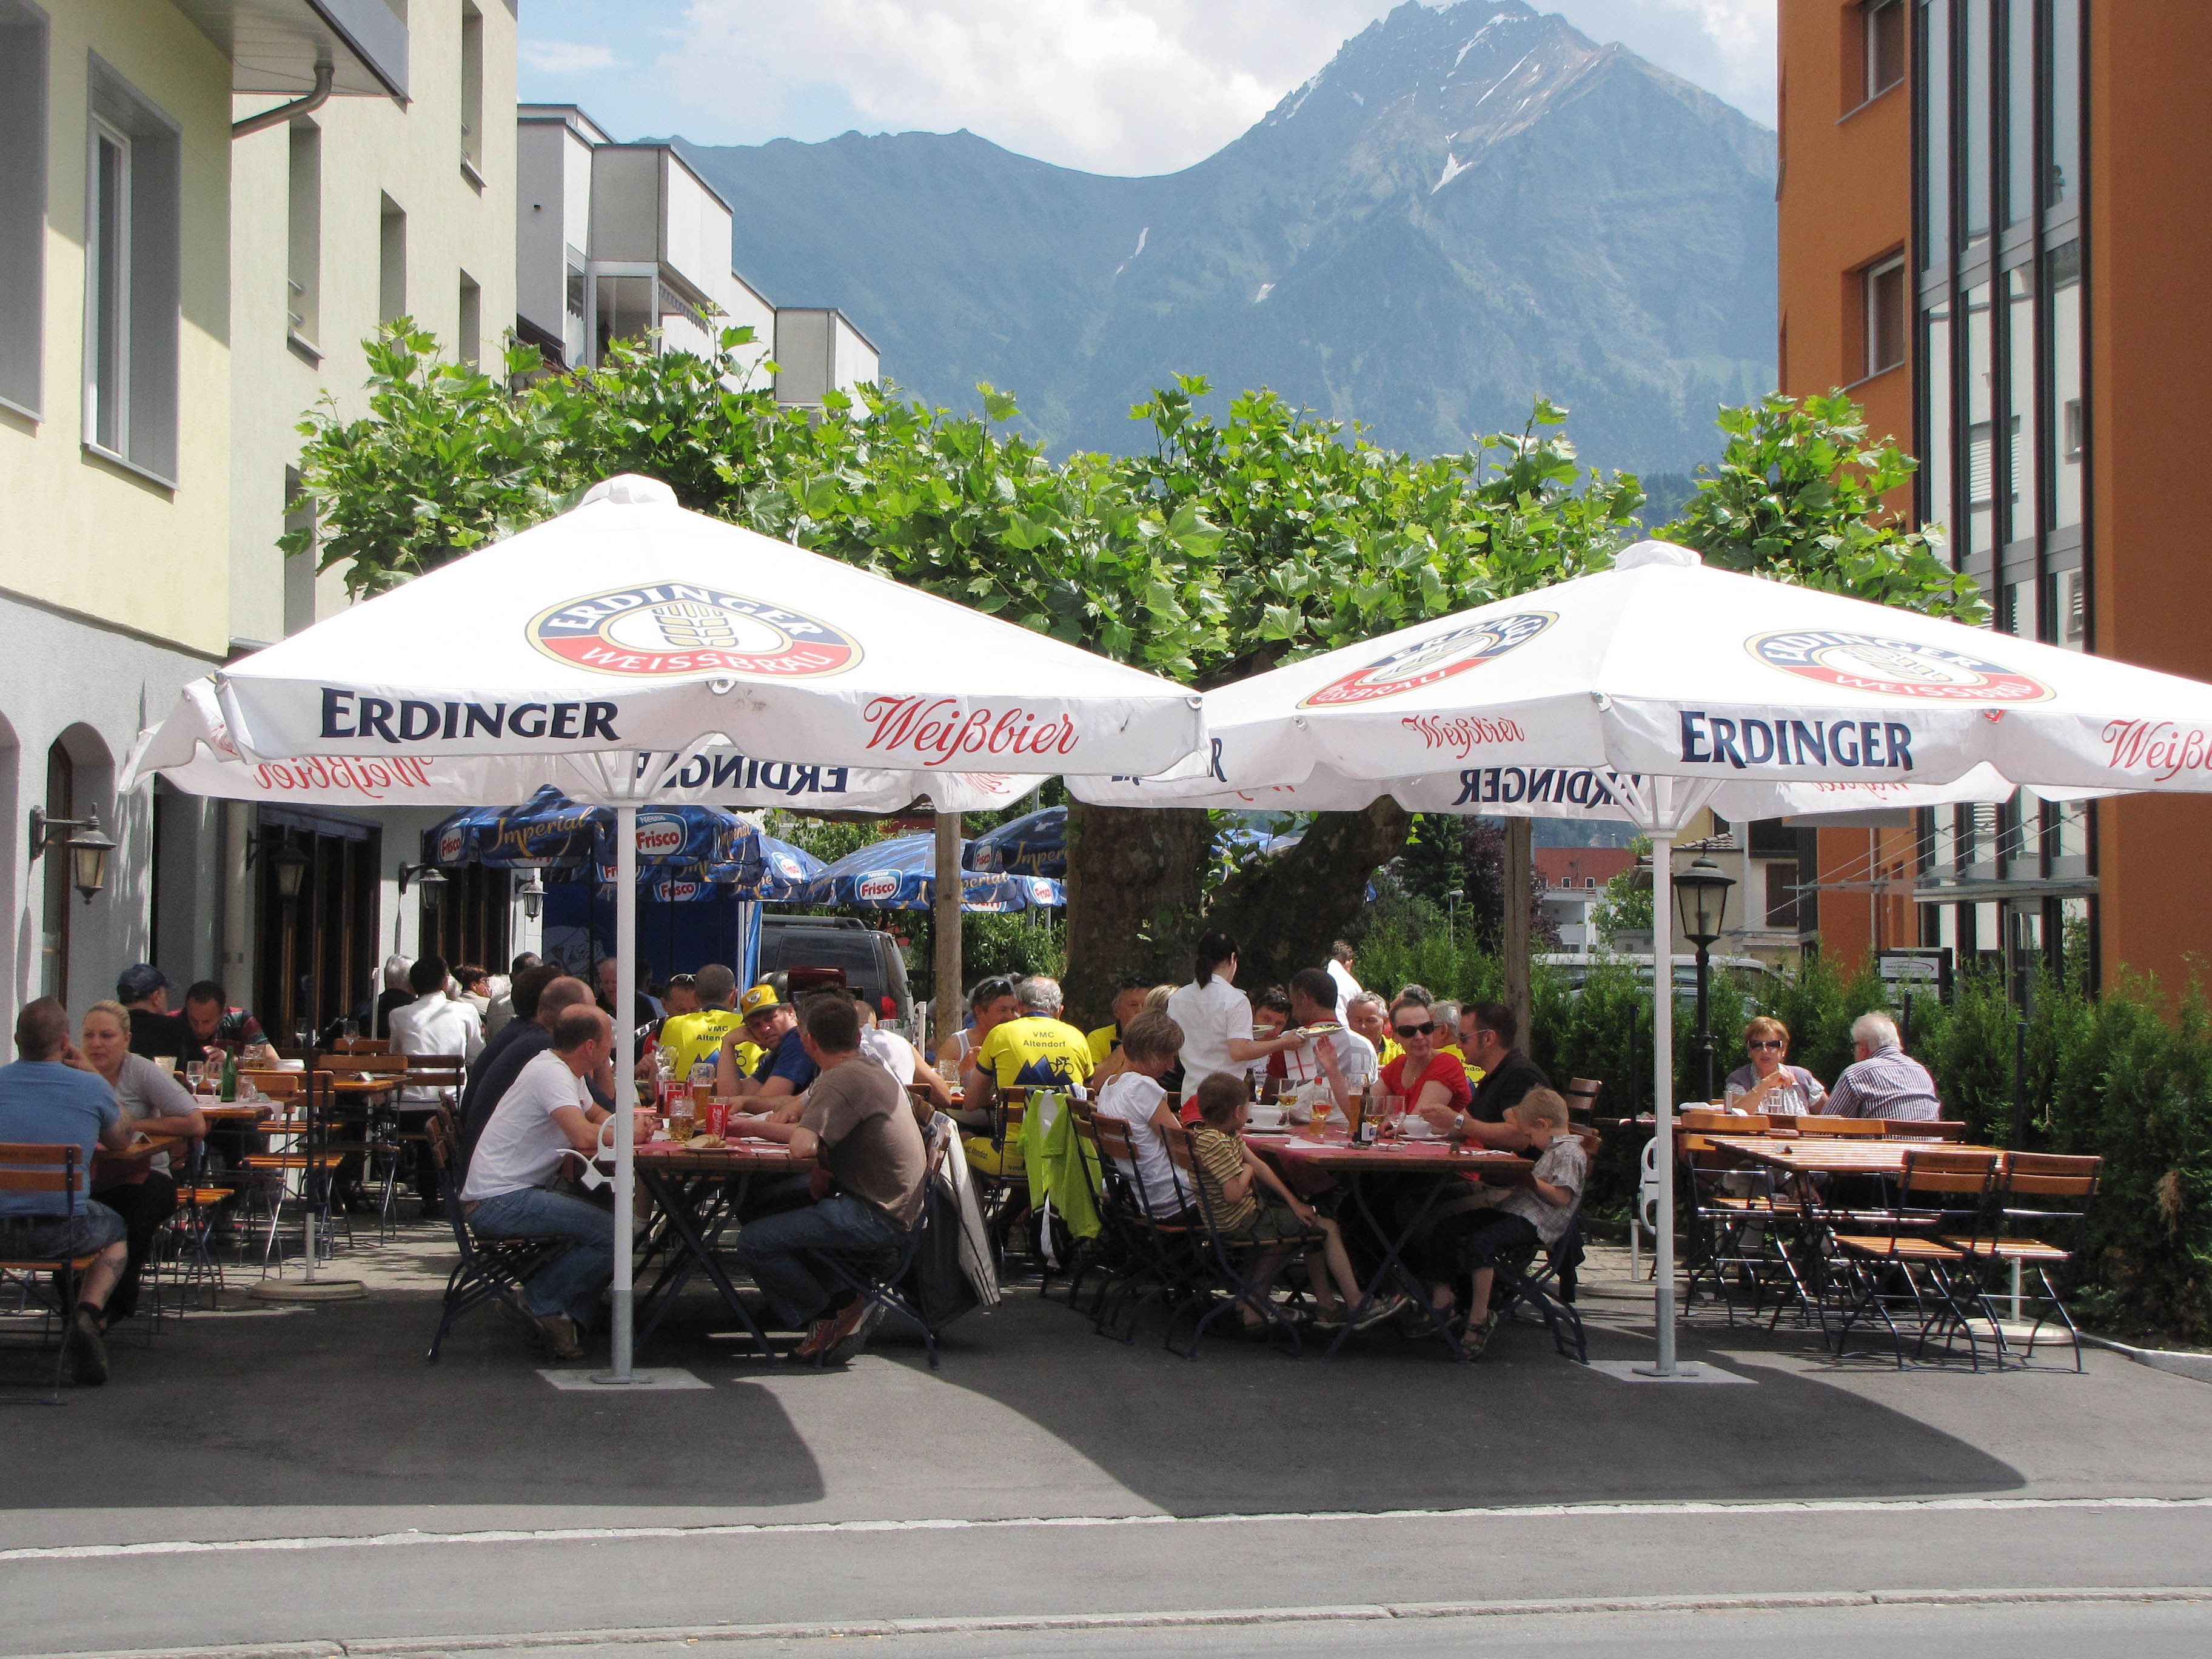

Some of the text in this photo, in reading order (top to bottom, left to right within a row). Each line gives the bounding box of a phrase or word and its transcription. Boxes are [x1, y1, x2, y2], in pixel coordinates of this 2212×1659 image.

[548, 584, 824, 636] ERDINGER
[1394, 615, 1542, 659] ERDINGER
[1764, 632, 1985, 668] ERDINGER
[581, 647, 835, 672] WEISSBRÄU
[320, 687, 622, 743] ERDINGER
[863, 695, 1079, 766] Weißbier
[1401, 715, 1525, 759] Weißbier
[1679, 711, 1912, 771] ERDINGER
[441, 836, 461, 857] Frisco
[485, 805, 594, 857] Imperial
[636, 830, 680, 850] Frisco
[862, 882, 895, 897] Frisco
[1023, 1039, 1065, 1048] Altendorf
